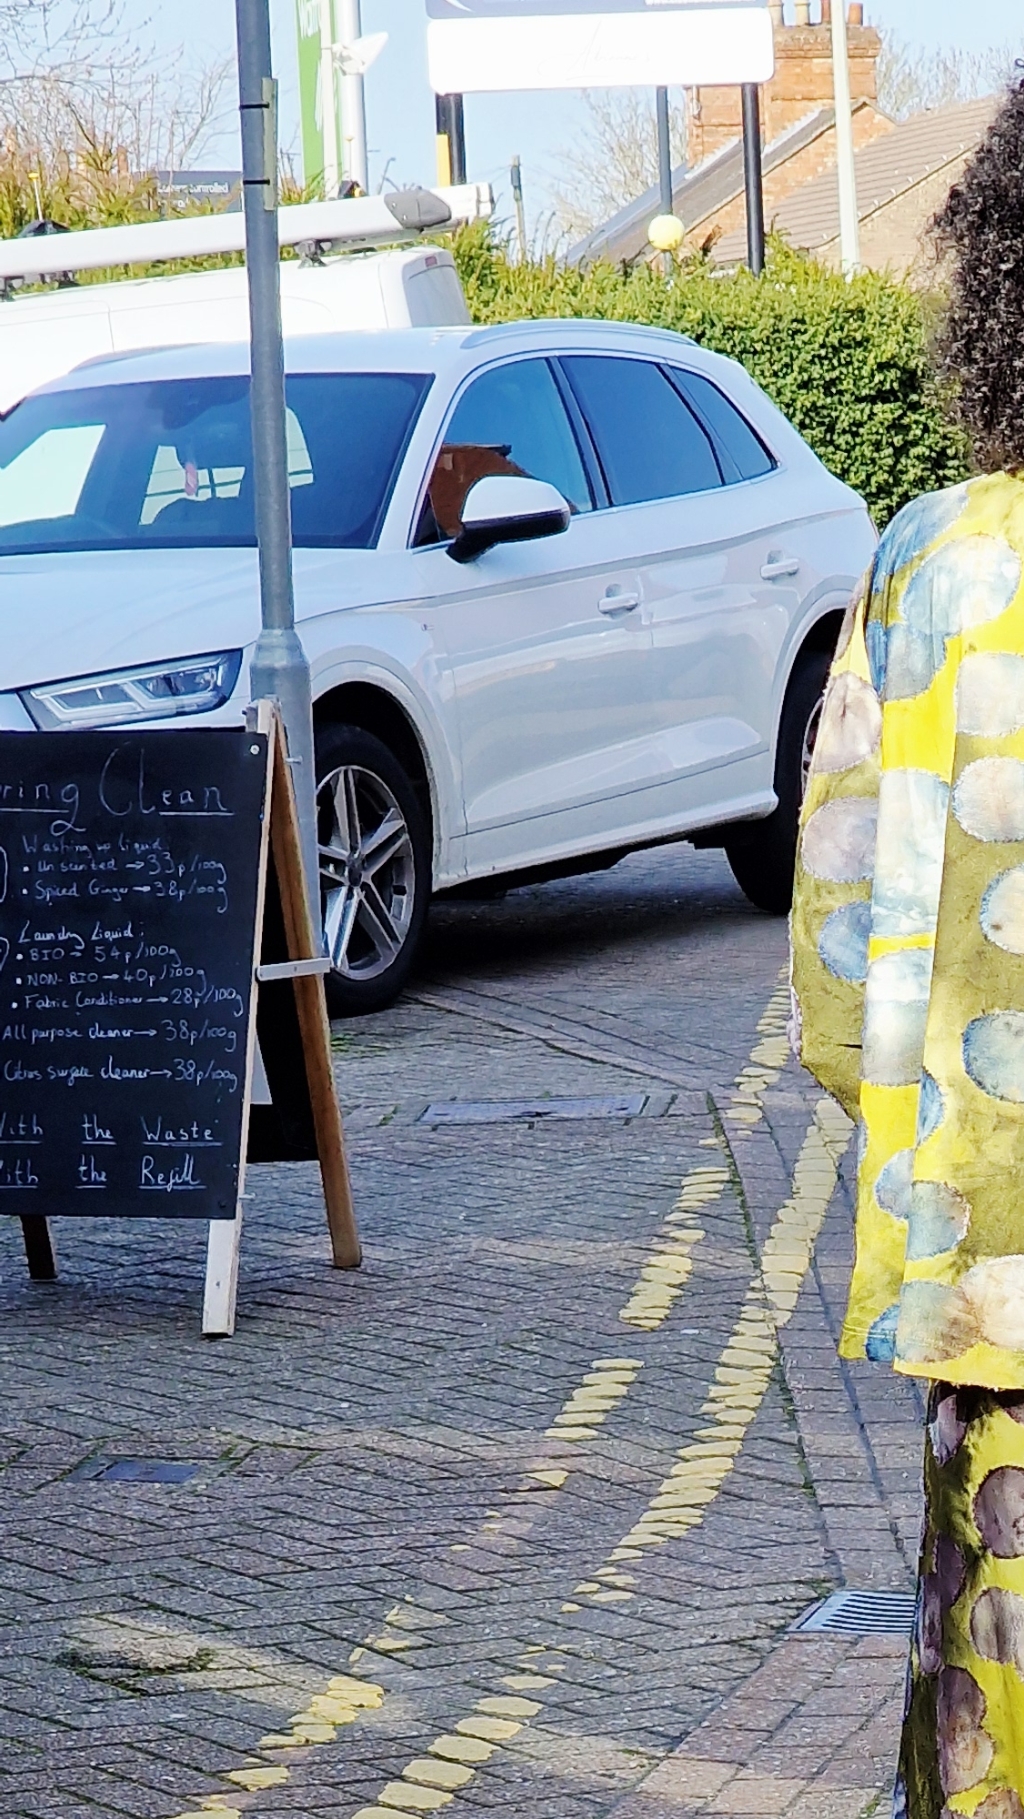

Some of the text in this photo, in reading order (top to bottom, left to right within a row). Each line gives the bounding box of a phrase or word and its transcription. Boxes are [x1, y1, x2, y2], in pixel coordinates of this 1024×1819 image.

[0, 742, 228, 837] ring Clean
[29, 947, 65, 961] BIO
[2, 1023, 27, 1040] All
[31, 1027, 84, 1045] purpose
[81, 1113, 114, 1140] the
[140, 1115, 214, 1141] Waste
[0, 1153, 200, 1192] ith the Refill
